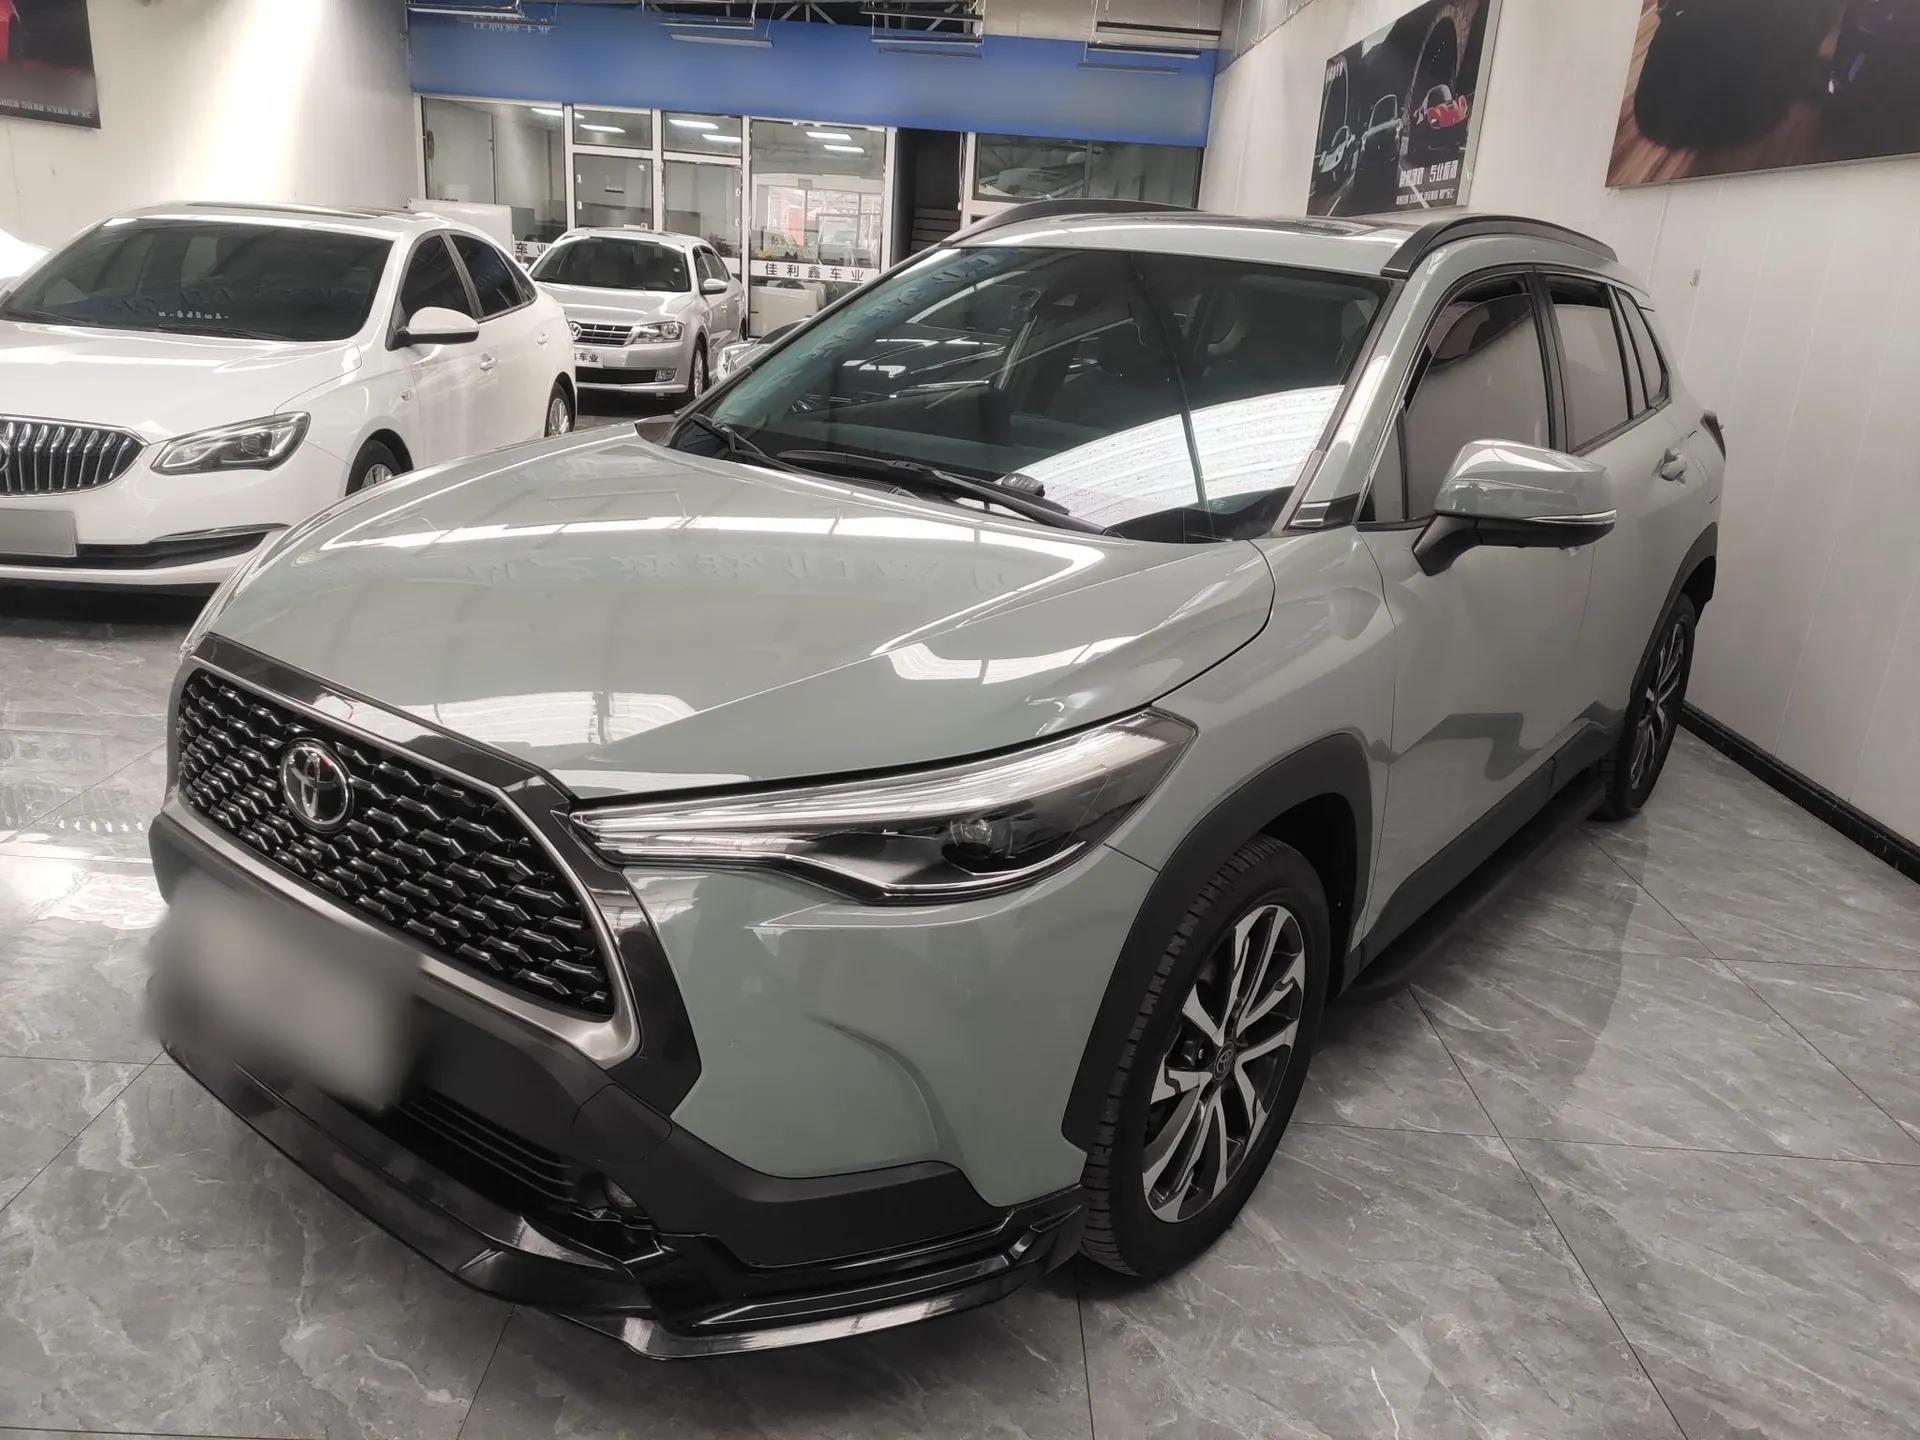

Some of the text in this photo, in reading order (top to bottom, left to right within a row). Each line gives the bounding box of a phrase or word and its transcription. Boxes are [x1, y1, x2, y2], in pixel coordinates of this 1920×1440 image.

[765, 263, 864, 282] 佳利鑫车业
